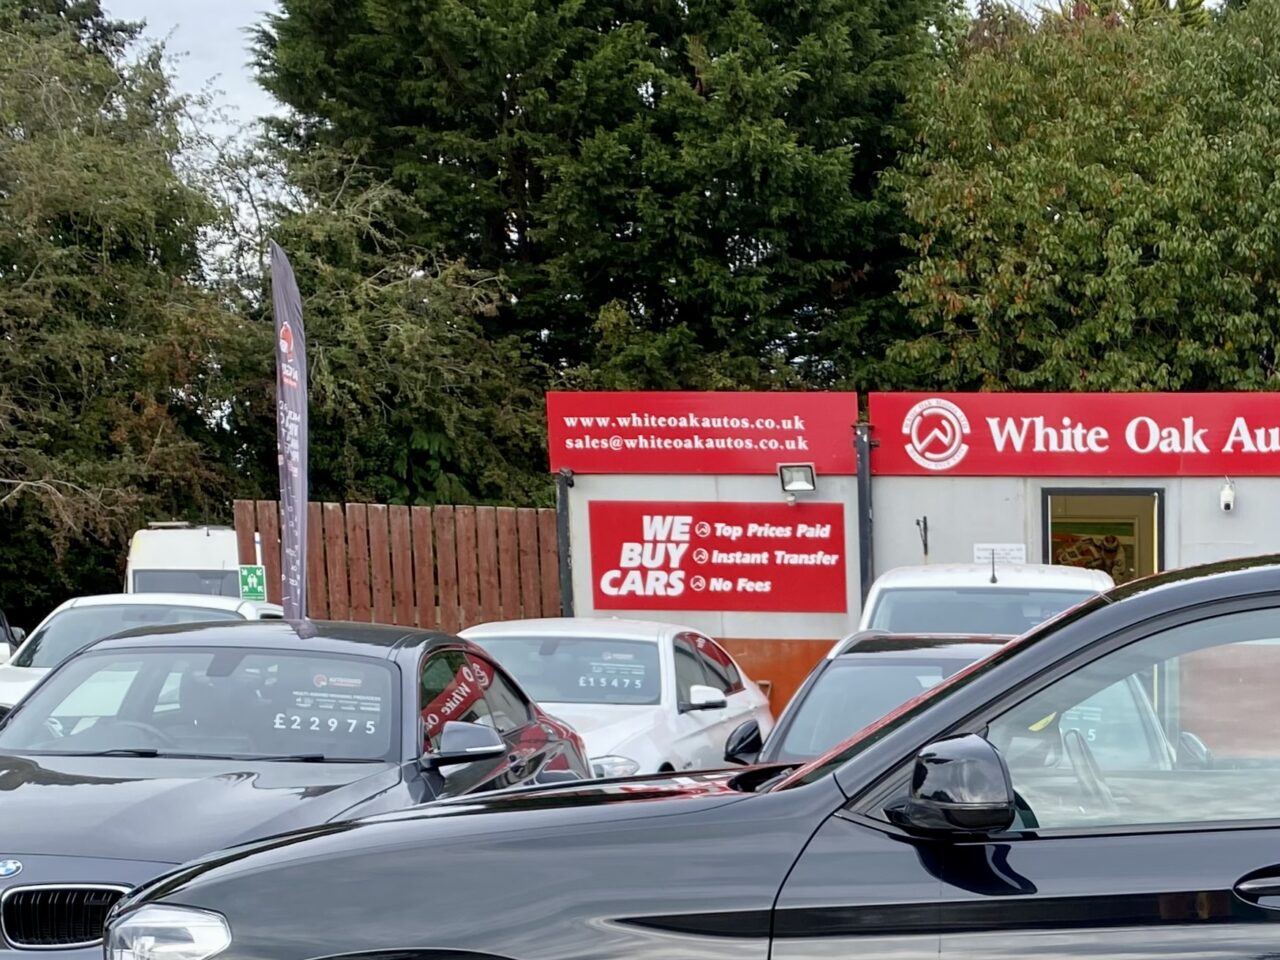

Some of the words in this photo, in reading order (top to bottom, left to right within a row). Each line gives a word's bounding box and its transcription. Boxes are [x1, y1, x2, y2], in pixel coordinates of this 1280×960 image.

[563, 413, 805, 430] www.whiteoakautos.co.uk
[565, 435, 808, 450] sales@whiteoakautos.co.uk
[986, 416, 1109, 452] White
[1125, 416, 1210, 453] Oak
[642, 515, 692, 541] WE
[714, 523, 742, 540] Top
[747, 523, 792, 538] Prices
[797, 524, 831, 539] Paid
[620, 542, 689, 568] BUY
[711, 550, 768, 565] Instant
[774, 551, 839, 565] Transfer
[600, 570, 685, 596] CARS
[709, 578, 732, 592] No
[737, 578, 771, 592] Fees
[274, 713, 375, 734] £22975
